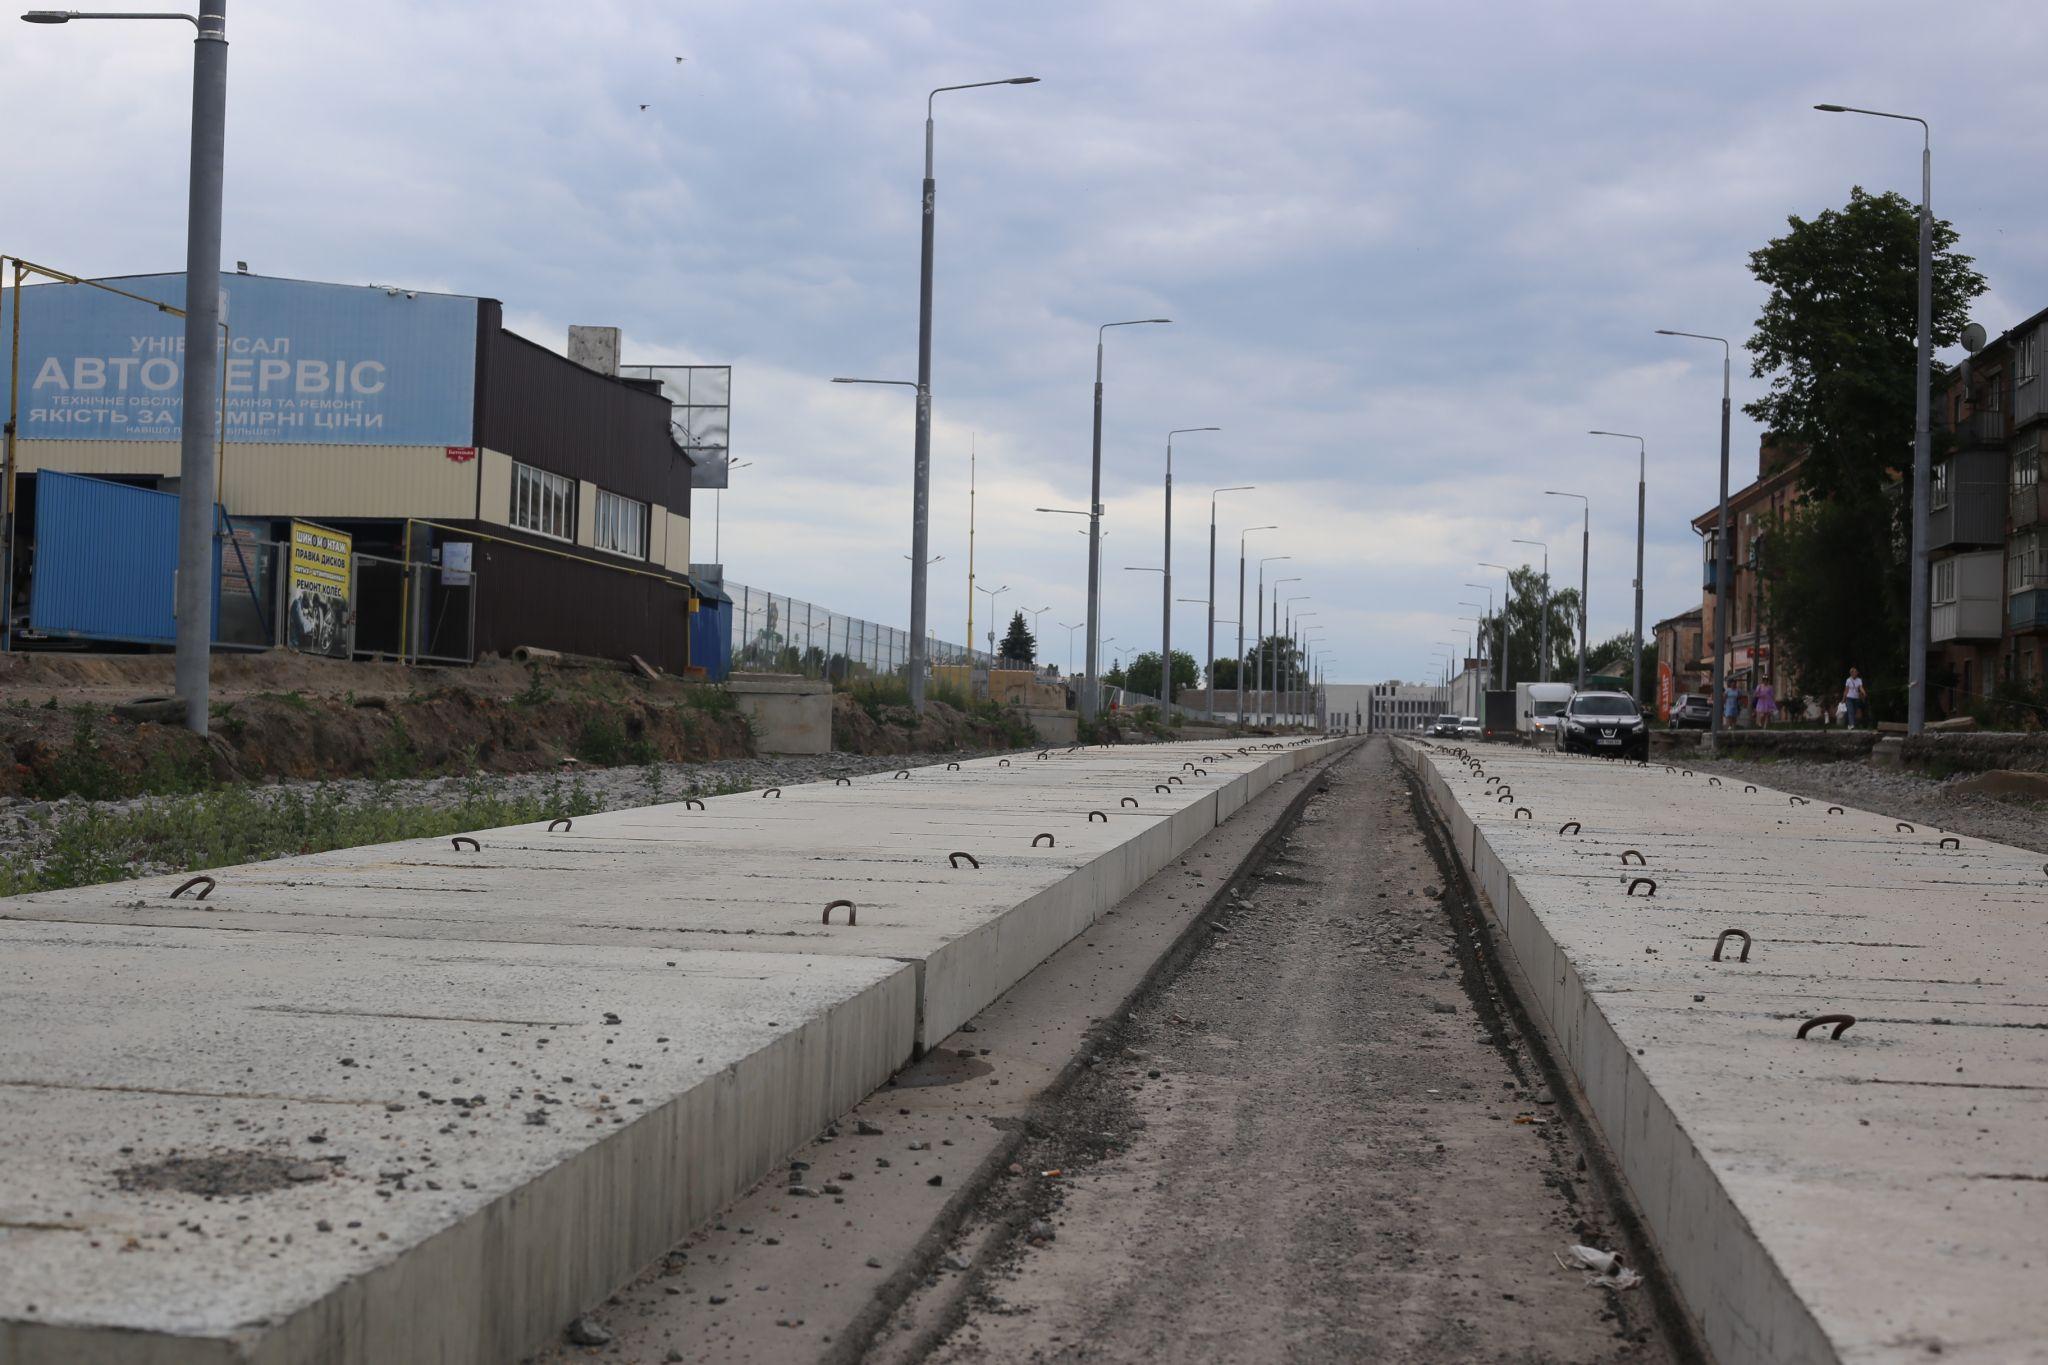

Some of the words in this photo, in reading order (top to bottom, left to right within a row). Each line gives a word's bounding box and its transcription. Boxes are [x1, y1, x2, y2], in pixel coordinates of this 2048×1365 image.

[130, 335, 290, 354] УНІВРСАЛ
[32, 357, 385, 394] АВТОЕРВІС
[52, 395, 125, 407] ТЕХНІЧНЕ
[276, 398, 296, 409] ТА
[299, 399, 365, 410] РЕМОНТ
[28, 408, 128, 423] ЯКІСТЬ
[137, 409, 175, 424] ЗА
[215, 410, 304, 427] МІРНІ
[314, 411, 384, 430] ЦІНИ
[296, 531, 346, 554] ШИНОМОНТАЖ
[295, 548, 320, 563] ПРАВКА
[321, 554, 346, 569] ДИСКОВ
[296, 578, 321, 593] РЕМОНТ
